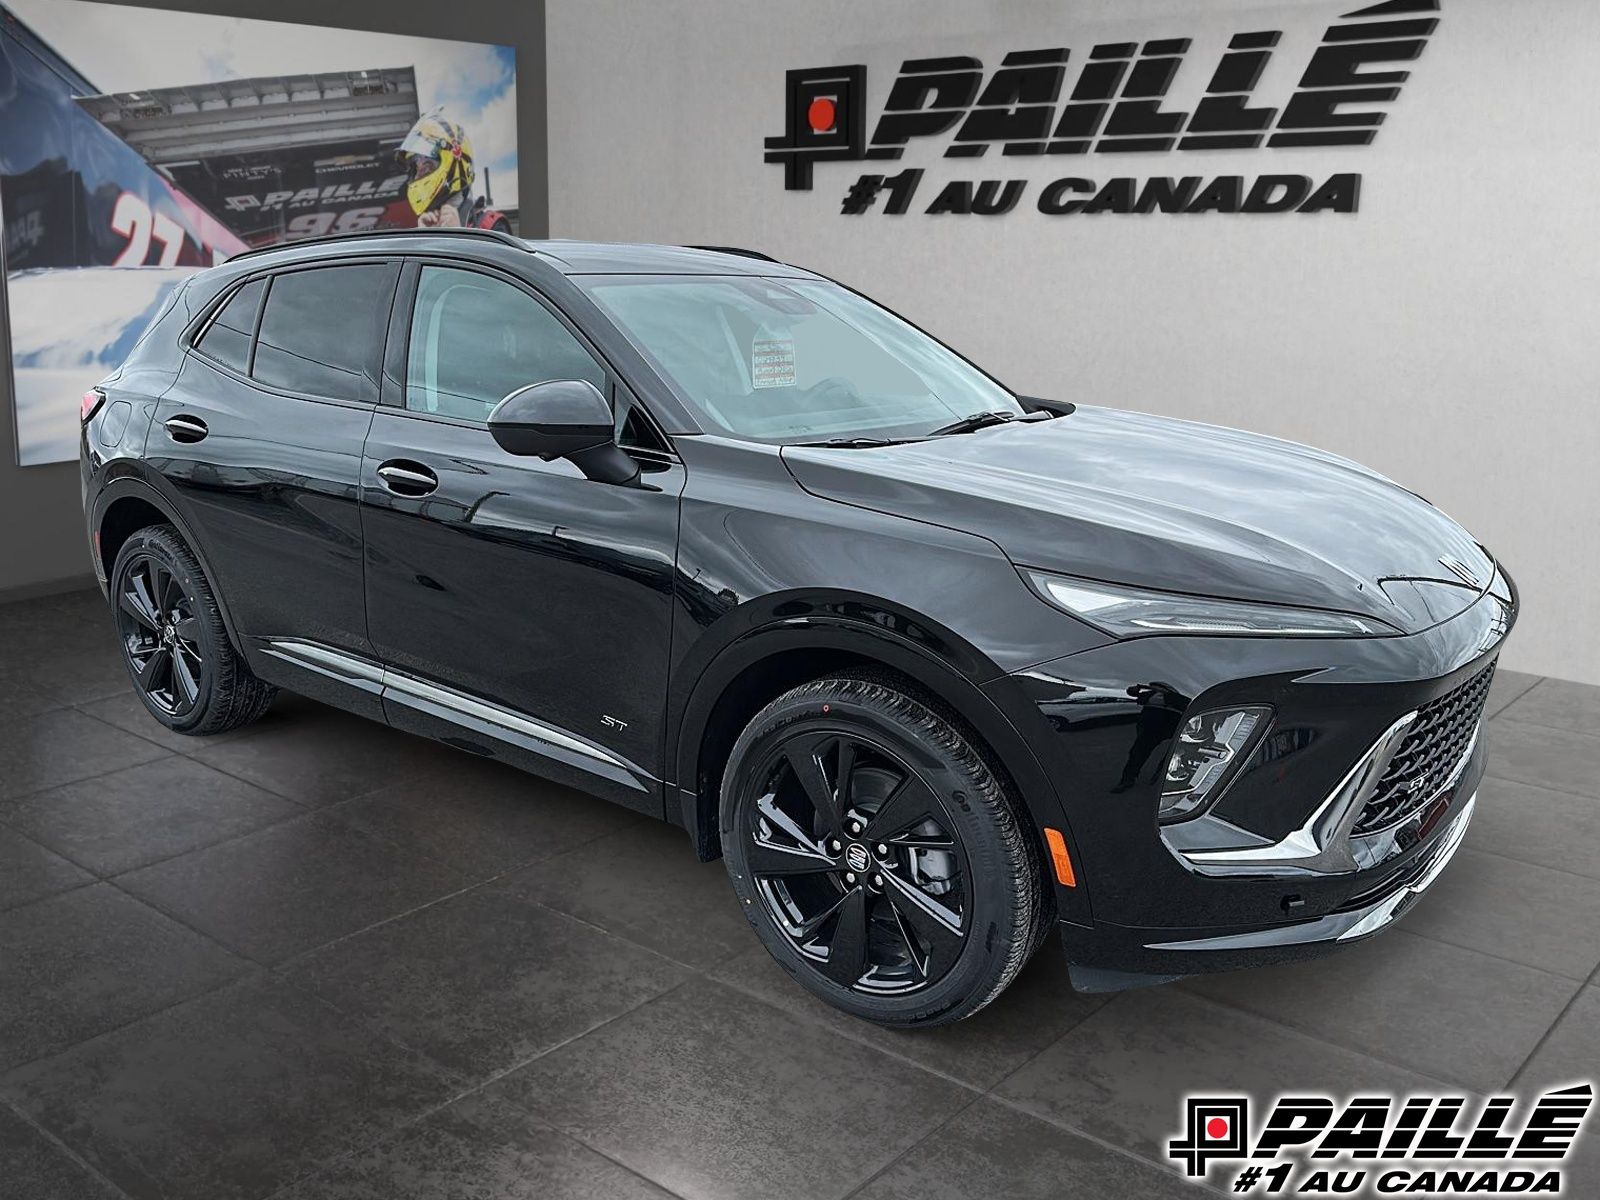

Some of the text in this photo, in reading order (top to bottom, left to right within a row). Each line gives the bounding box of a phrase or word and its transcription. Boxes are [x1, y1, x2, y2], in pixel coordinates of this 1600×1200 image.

[865, 0, 1441, 160] PAILLÉ
[841, 168, 1361, 216] #1 AU CANADA
[111, 192, 185, 267] 27
[286, 206, 385, 240] 96
[600, 715, 627, 731] ST
